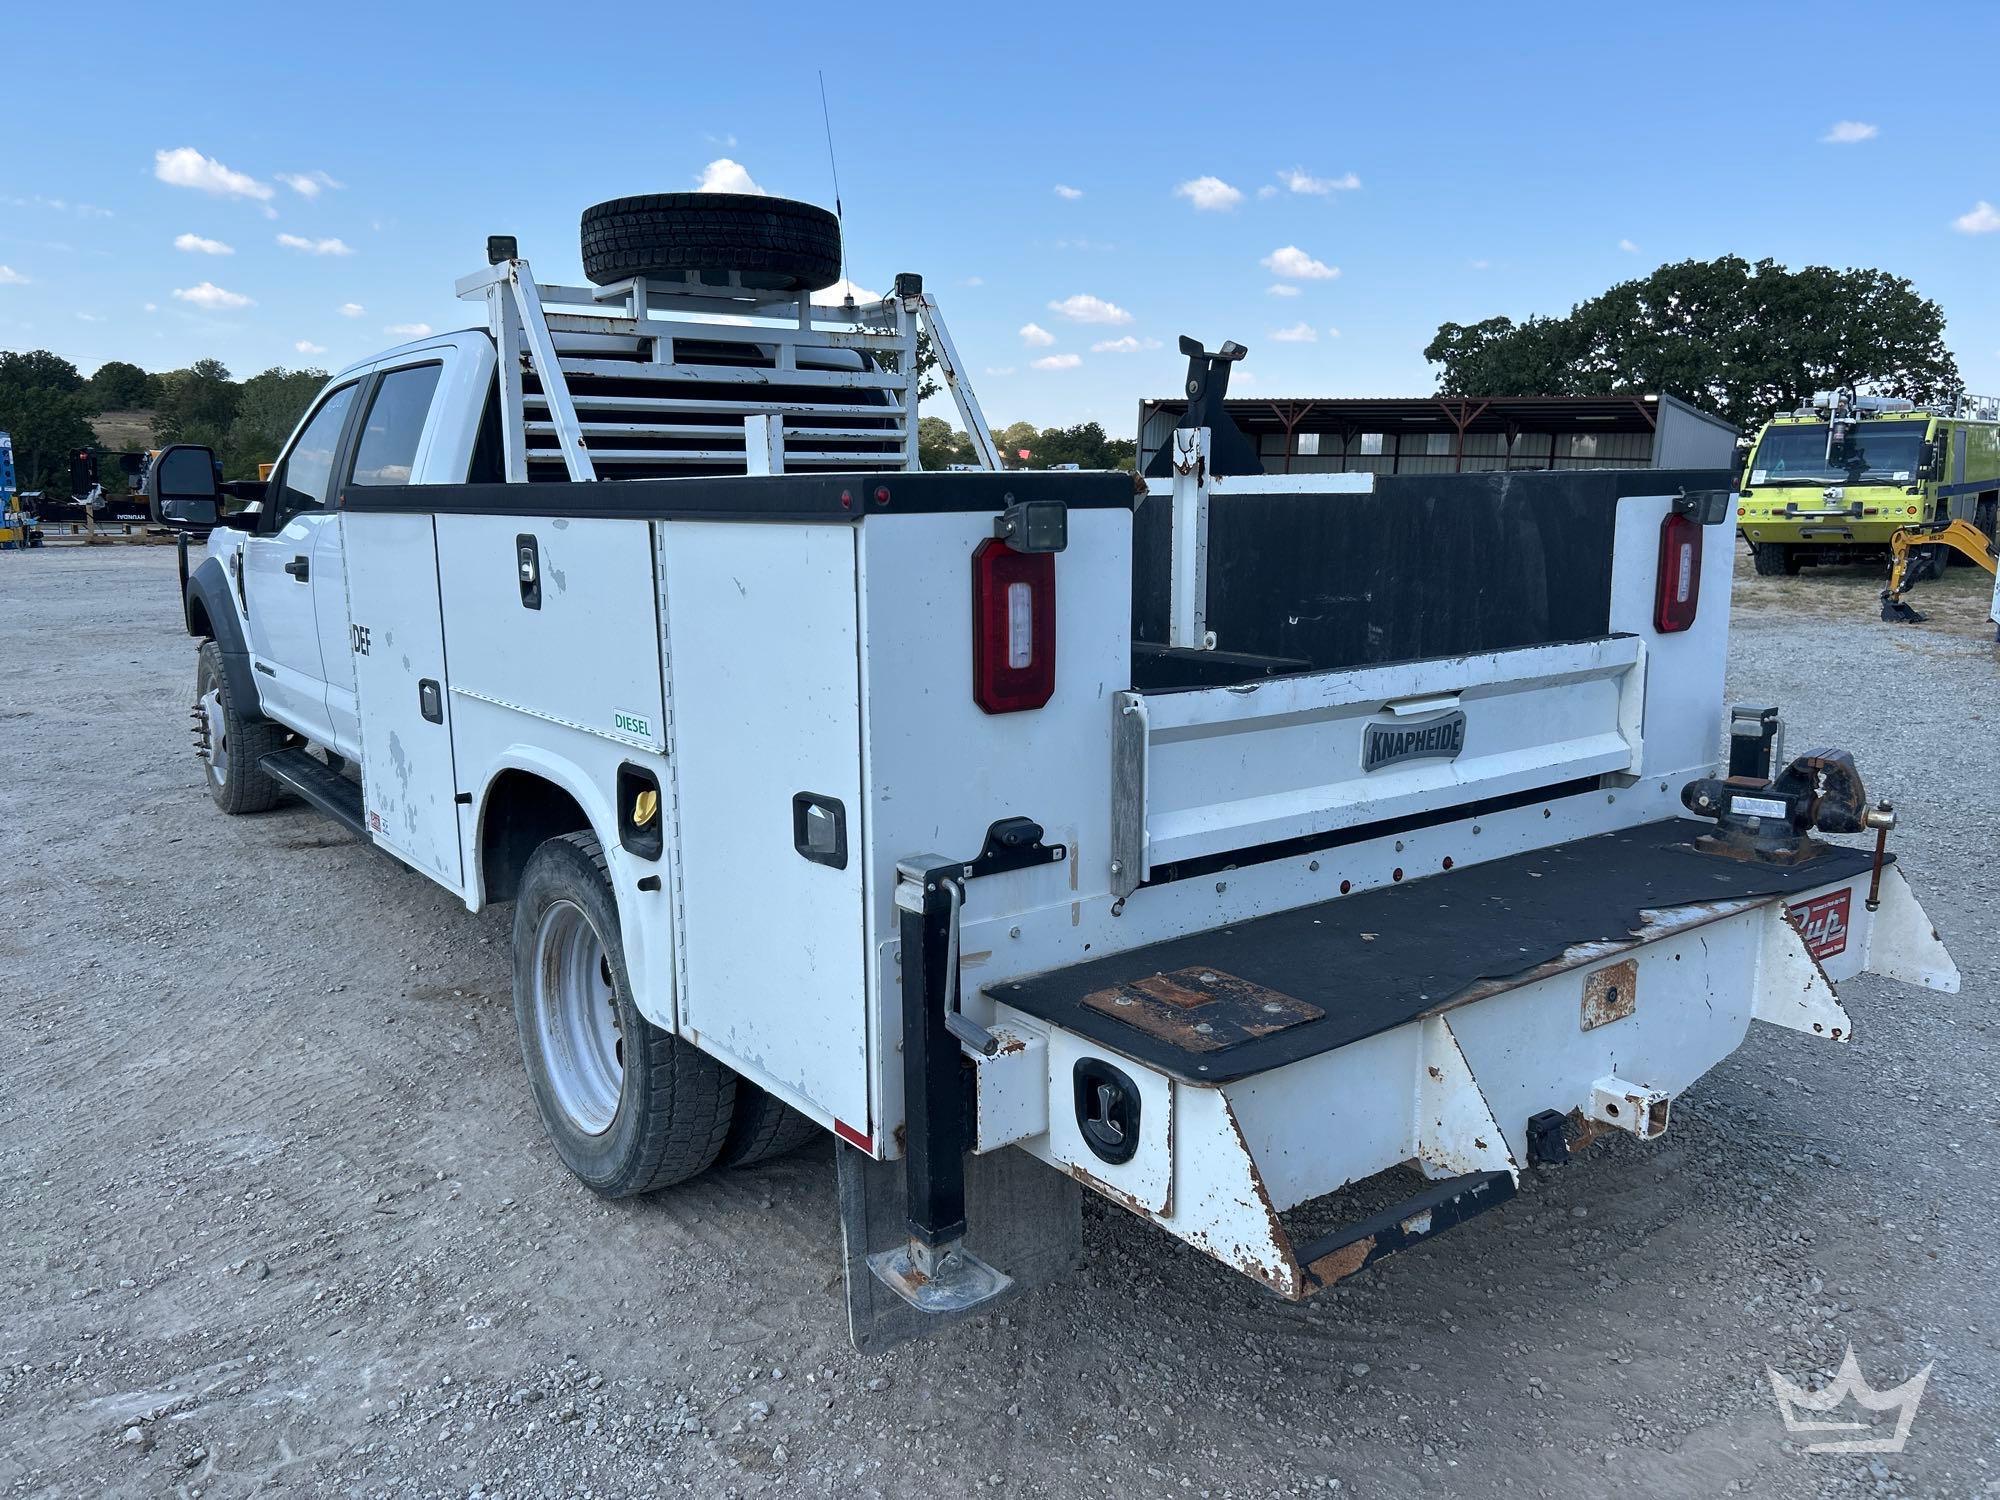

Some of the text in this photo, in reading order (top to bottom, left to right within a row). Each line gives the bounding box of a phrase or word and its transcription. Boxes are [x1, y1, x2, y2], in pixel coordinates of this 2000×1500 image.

[352, 624, 371, 656] DEF
[615, 713, 652, 736] DIESEL
[1370, 719, 1462, 765] KNAPHEIDE
